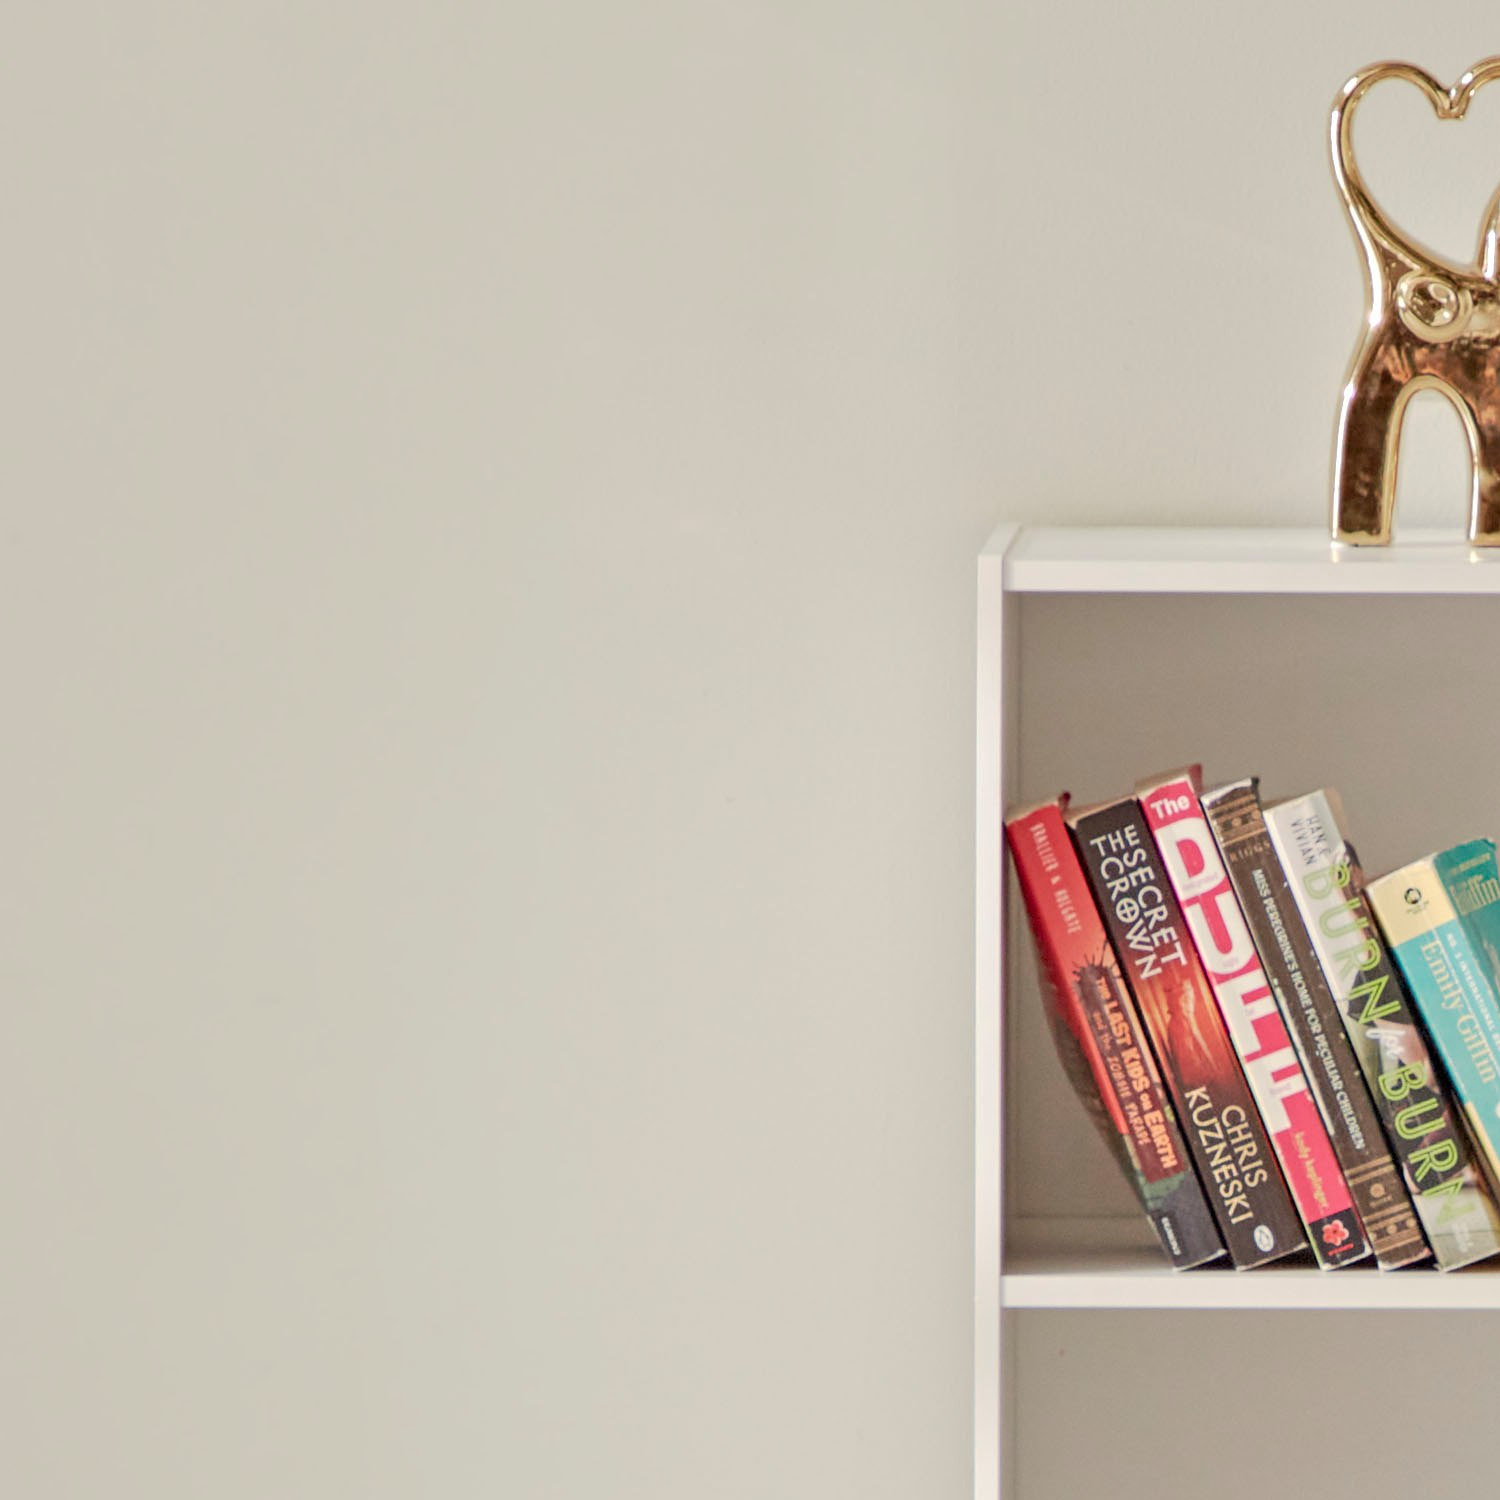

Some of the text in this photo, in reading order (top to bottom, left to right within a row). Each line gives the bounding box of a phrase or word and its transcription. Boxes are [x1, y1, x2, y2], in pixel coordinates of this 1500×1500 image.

[1090, 824, 1140, 857] THE
[1150, 795, 1190, 819] The
[1291, 818, 1317, 866] VIVIAN
[1101, 857, 1163, 980] CROWN
[1123, 848, 1188, 966] SECRET
[1154, 817, 1308, 1136] DUFF
[1251, 867, 1365, 1150] MISS PEREGRINE'S HOME FOR PECULIAR CHILDREN
[1420, 939, 1497, 1083] Emily Giffin
[1104, 1000, 1132, 1046] LAST
[1121, 1047, 1151, 1093] KIDS
[1144, 1109, 1179, 1169] EARTH
[1303, 861, 1476, 1228] BURN for BURN
[1184, 1086, 1254, 1224] KUZNESKI
[1221, 1105, 1268, 1188] CHRIS
